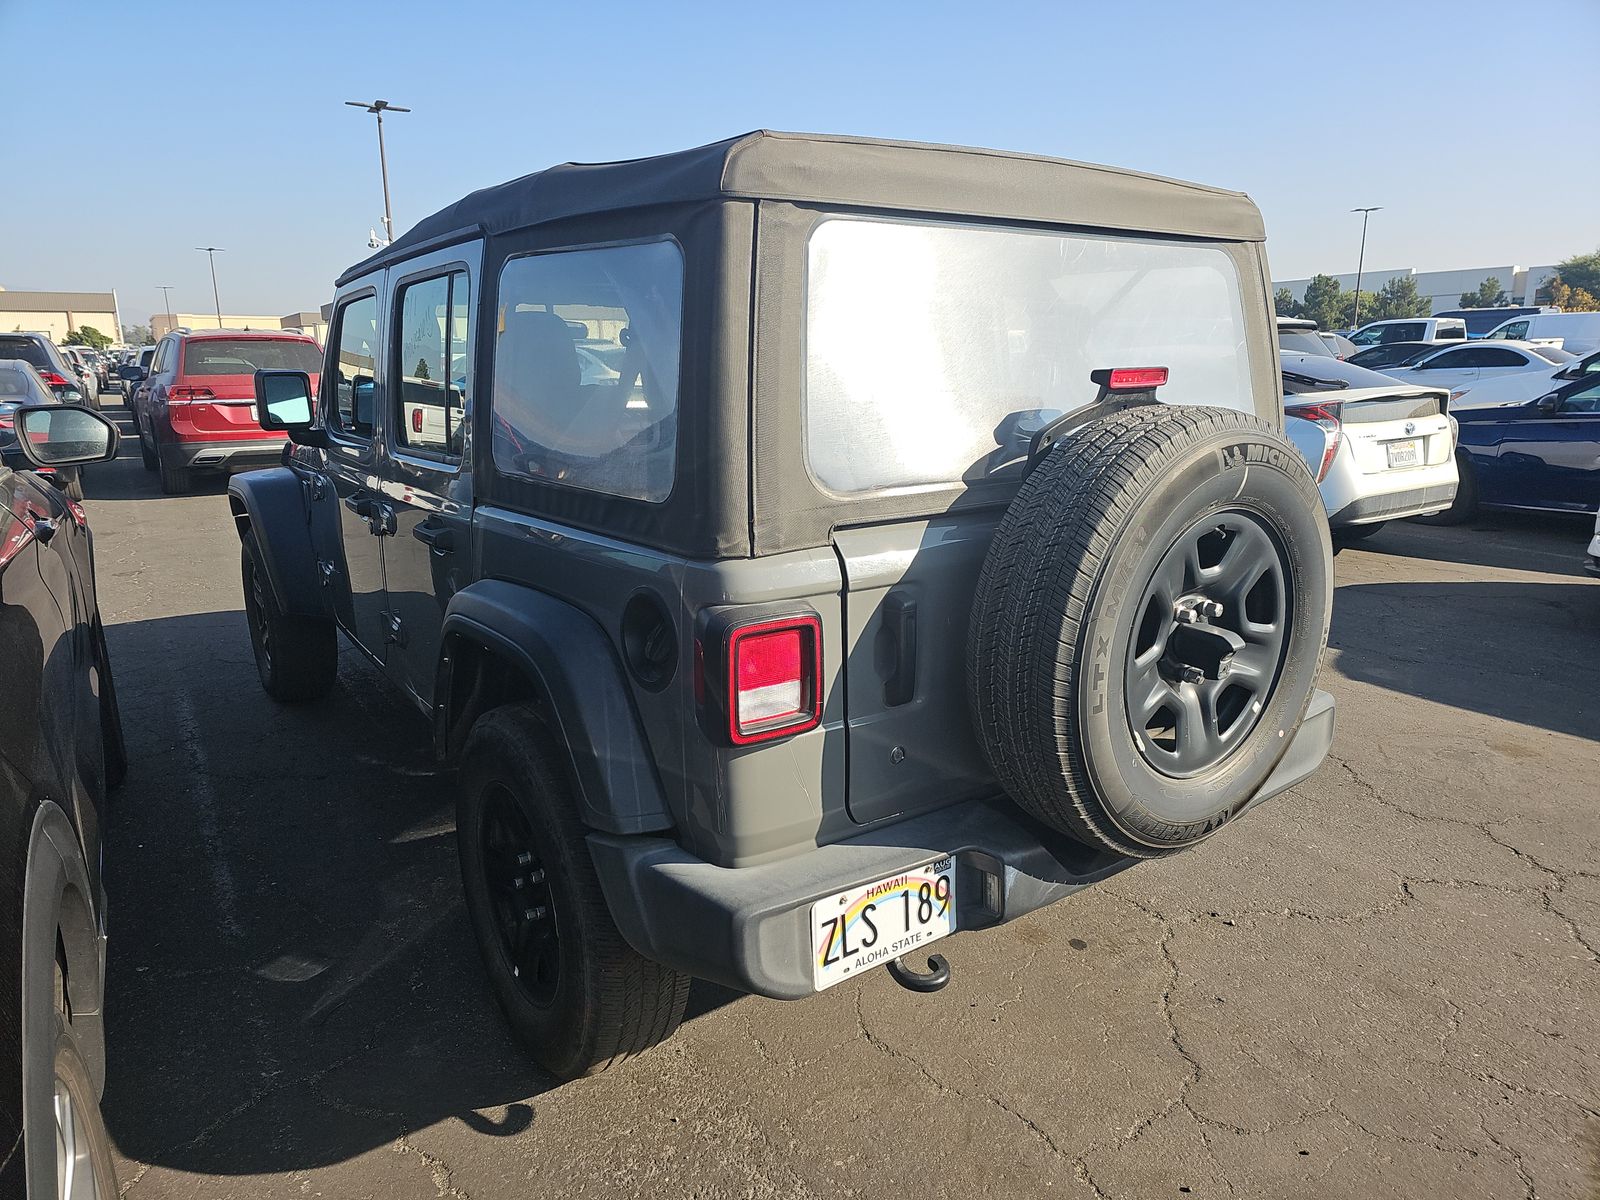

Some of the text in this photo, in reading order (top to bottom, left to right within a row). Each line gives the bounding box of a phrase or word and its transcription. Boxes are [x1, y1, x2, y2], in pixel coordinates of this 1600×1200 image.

[1246, 444, 1318, 507] MICHELIN
[1093, 635, 1110, 714] LTX
[866, 875, 908, 899] HAWAII
[934, 858, 951, 869] AUG
[821, 875, 951, 968] ZLS 189
[855, 932, 922, 969] ALOHA STATE
